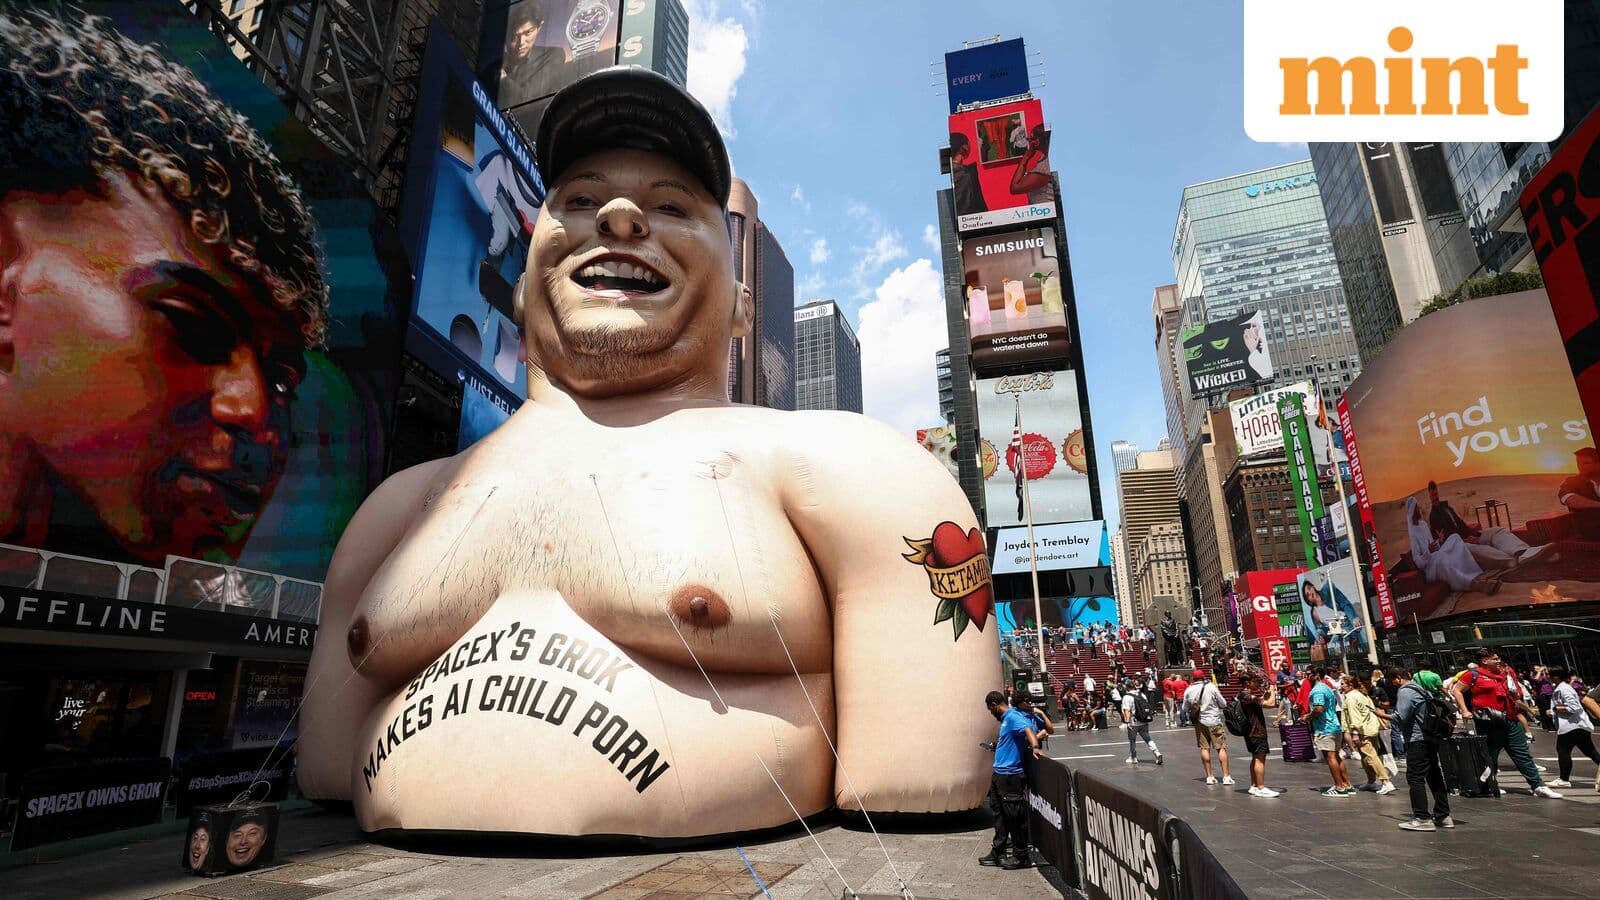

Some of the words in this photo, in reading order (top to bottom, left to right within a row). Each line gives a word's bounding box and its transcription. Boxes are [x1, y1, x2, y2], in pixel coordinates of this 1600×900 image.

[952, 72, 983, 86] EVERY
[472, 81, 507, 136] GRAND
[507, 132, 530, 167] SLAM
[1012, 206, 1051, 219] ArtPop
[975, 237, 1045, 257] SAMSUNG
[992, 343, 1026, 351] watered
[1026, 340, 1049, 348] down
[1008, 334, 1036, 342] doesn't
[1239, 393, 1276, 418] LITTLE
[1276, 391, 1307, 403] SP
[1340, 410, 1353, 440] FREE
[1417, 396, 1493, 445] Find
[1446, 422, 1548, 467] your
[1289, 421, 1320, 542] CANNABIS
[1042, 535, 1090, 546] Tremblay
[1014, 552, 1079, 565] @jadendoes.art
[405, 621, 536, 700] SPACEX'S
[539, 633, 634, 693] GROK
[1268, 640, 1286, 671] tkts
[63, 697, 85, 709] live
[184, 690, 217, 701] OPEN
[363, 695, 433, 792] MAKES
[441, 678, 473, 720] AI
[478, 675, 577, 726] CHILD
[573, 701, 670, 794] PORN
[26, 791, 86, 818] SPACEX
[86, 785, 128, 807] OWNS
[128, 782, 163, 800] GROK
[1085, 840, 1100, 887] AI
[1111, 810, 1160, 890] MAKES
